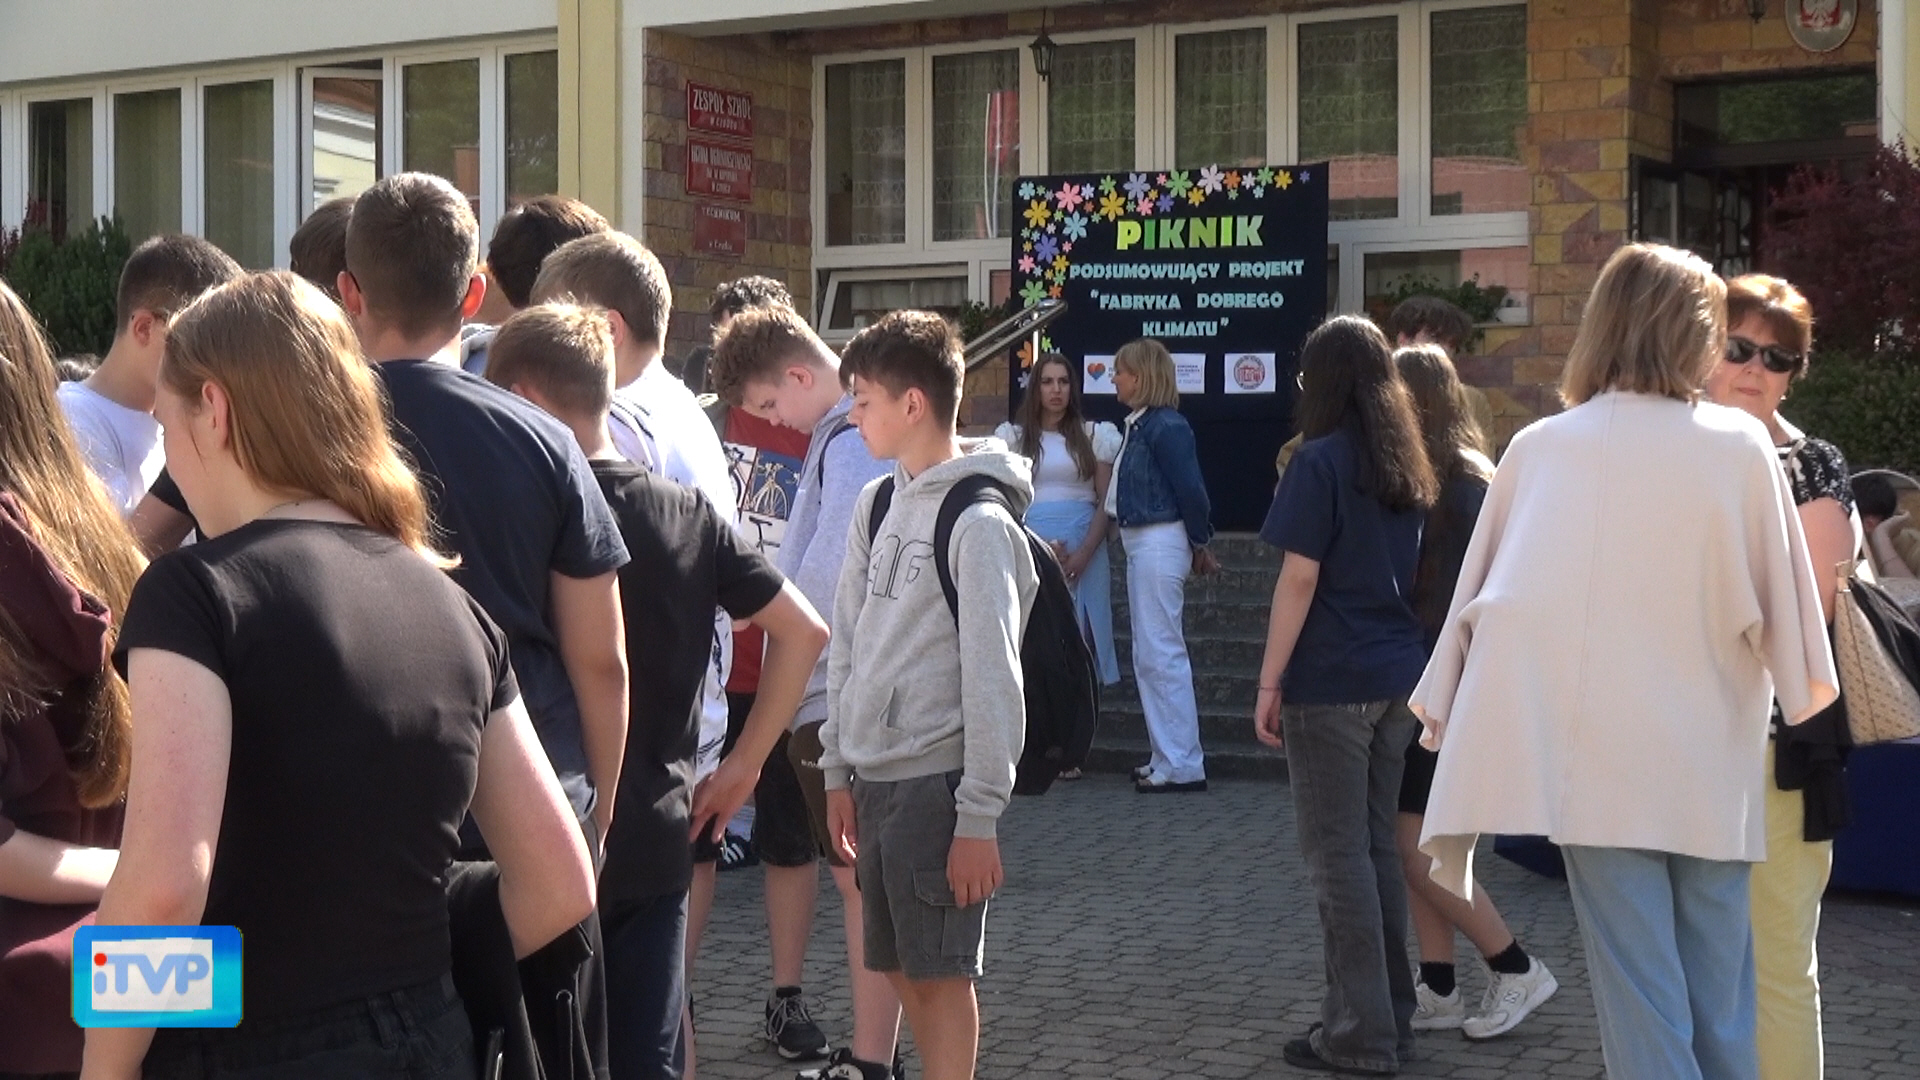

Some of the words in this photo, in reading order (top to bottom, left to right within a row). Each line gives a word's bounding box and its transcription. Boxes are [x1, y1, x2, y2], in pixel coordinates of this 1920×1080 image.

[1116, 215, 1264, 250] PIKNIK
[1069, 261, 1221, 284] PODSUMOWUJĄCY
[1228, 259, 1305, 281] PROJEKT
[1196, 291, 1285, 309] DOBREGO
